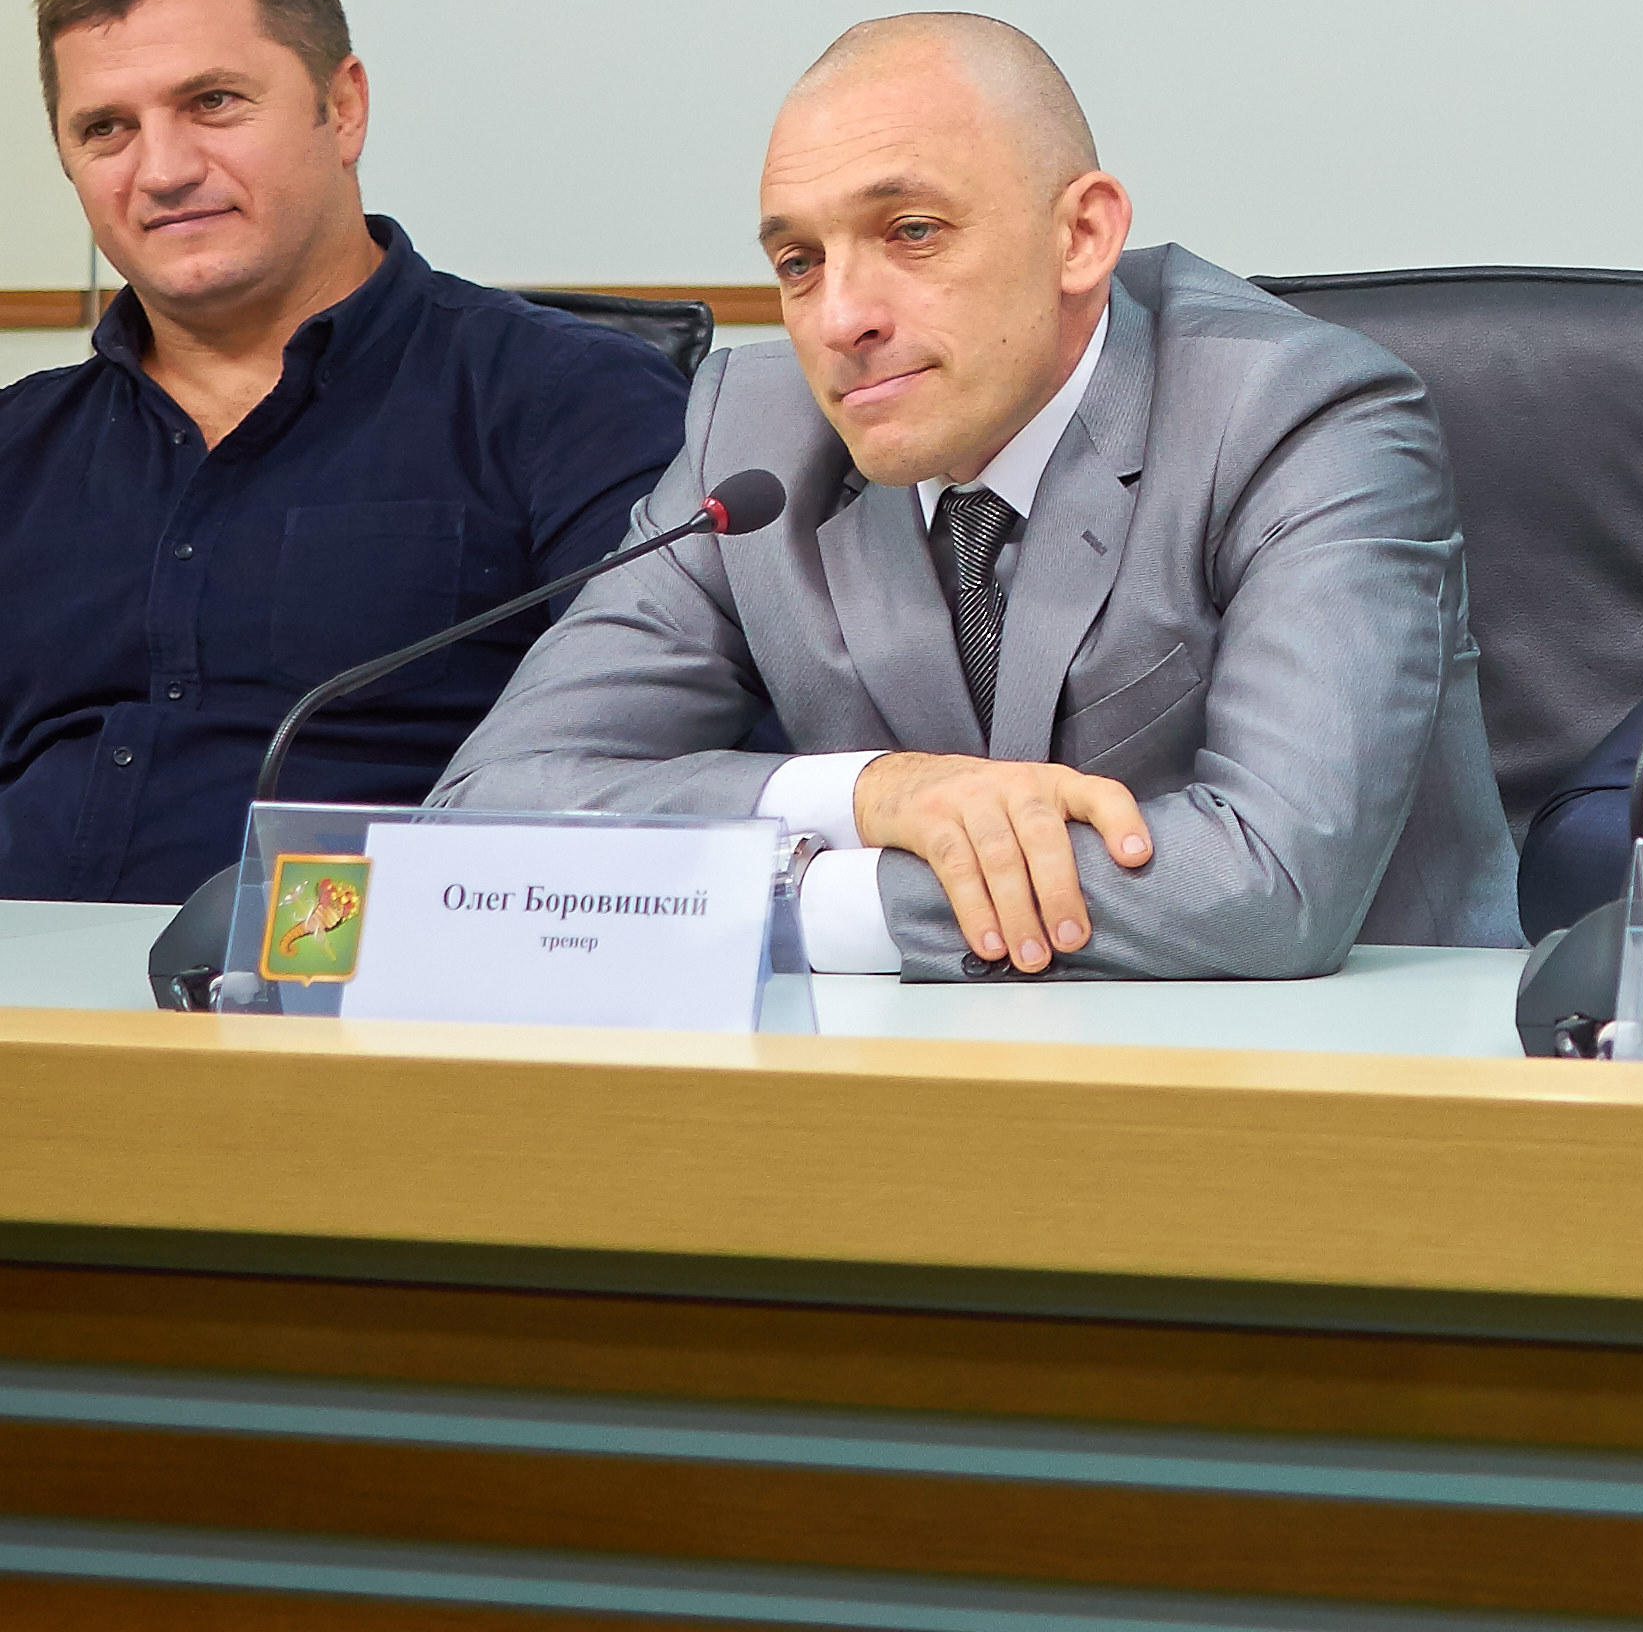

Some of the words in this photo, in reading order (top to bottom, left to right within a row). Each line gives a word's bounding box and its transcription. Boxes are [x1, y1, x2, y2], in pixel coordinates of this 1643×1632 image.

[442, 882, 516, 912] Олег
[523, 884, 710, 921] Боровицкий
[540, 935, 600, 952] тренер
